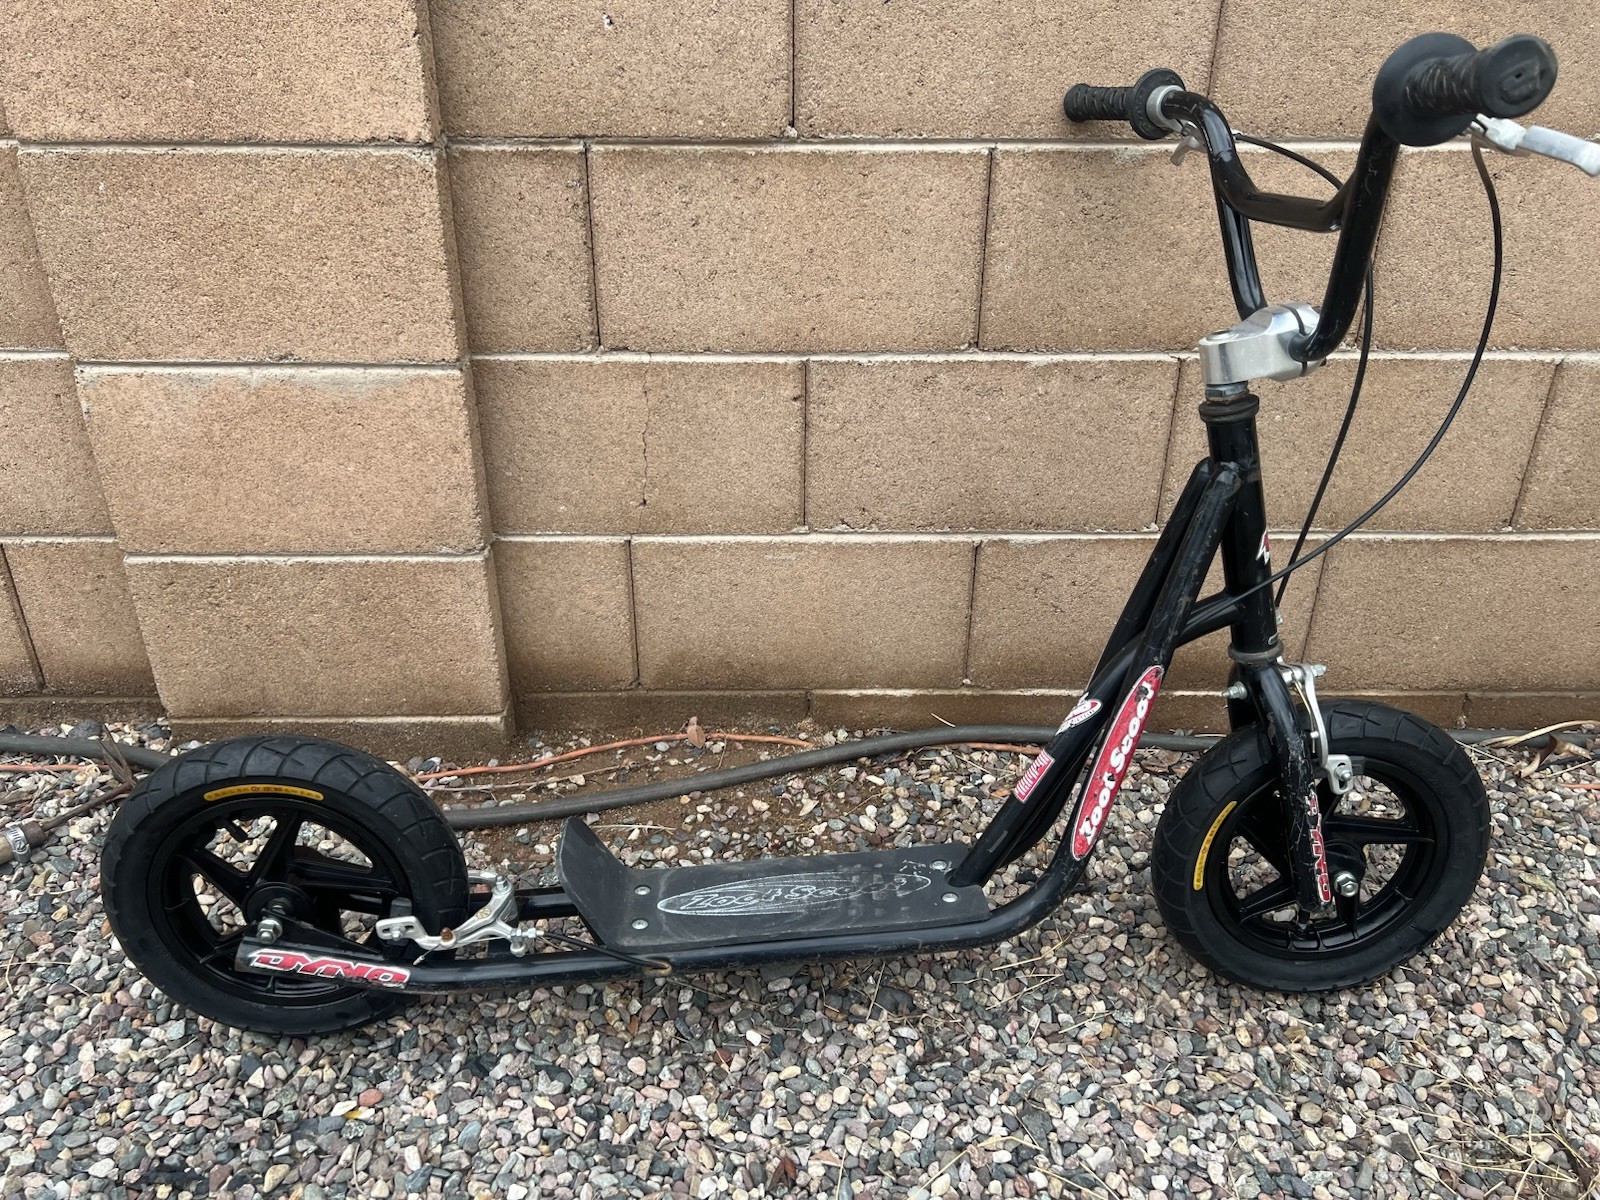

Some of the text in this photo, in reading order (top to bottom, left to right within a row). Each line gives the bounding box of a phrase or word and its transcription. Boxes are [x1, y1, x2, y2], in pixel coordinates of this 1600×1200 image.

[1079, 681, 1154, 845] Zoot Scoot
[250, 949, 411, 988] DYNO
